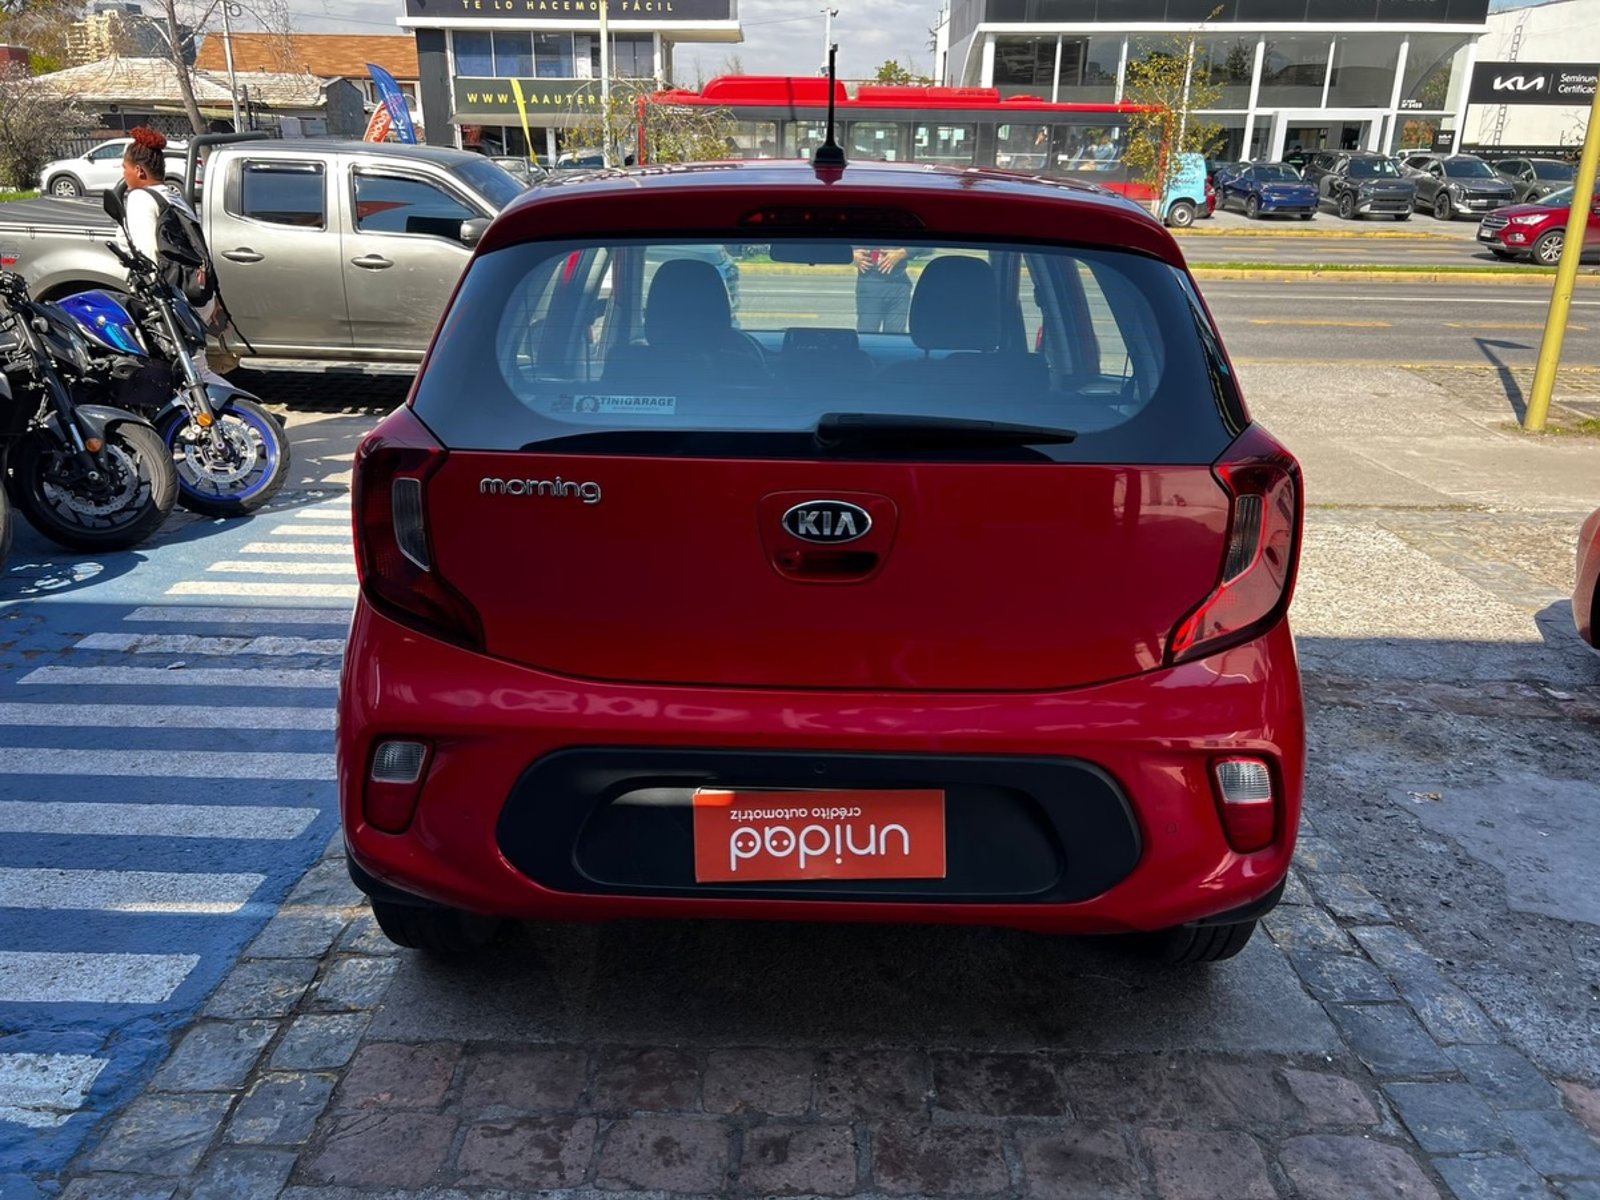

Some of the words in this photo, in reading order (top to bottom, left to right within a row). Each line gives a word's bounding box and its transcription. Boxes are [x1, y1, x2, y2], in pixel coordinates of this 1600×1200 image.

[463, 1, 481, 9] TE
[494, 1, 513, 9] LO
[526, 1, 609, 10] HACEMO
[622, 0, 673, 11] FÁCIL
[1493, 76, 1545, 90] KIA
[600, 397, 674, 407] TINIGARAGE
[480, 476, 602, 503] morning
[797, 510, 858, 536] KIA
[730, 807, 808, 822] automotriz
[812, 807, 862, 819] crédito
[729, 823, 910, 872] unidad
